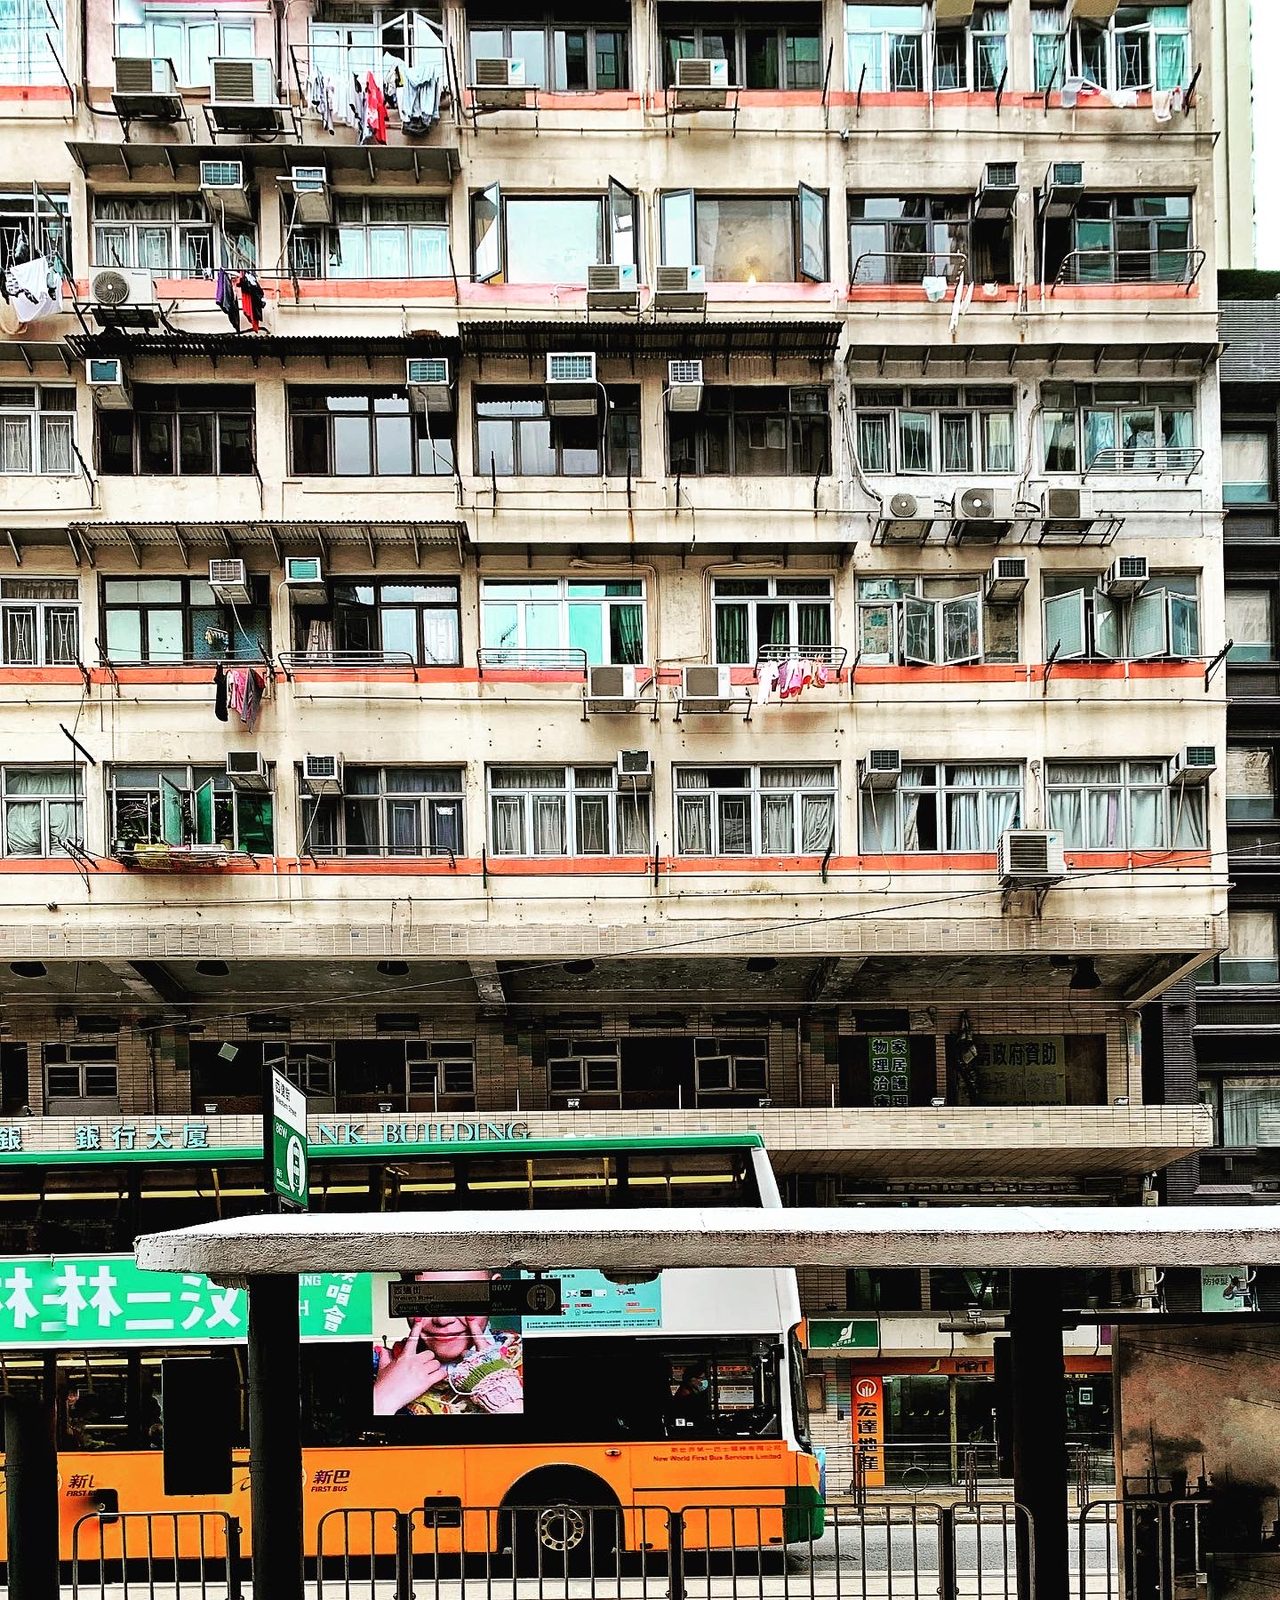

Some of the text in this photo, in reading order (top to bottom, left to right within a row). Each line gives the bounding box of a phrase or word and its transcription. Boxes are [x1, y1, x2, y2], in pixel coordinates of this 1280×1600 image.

[73, 1123, 209, 1150] 銀行大廈
[381, 1121, 532, 1143] BUILDING
[313, 1470, 350, 1484] 新巴
